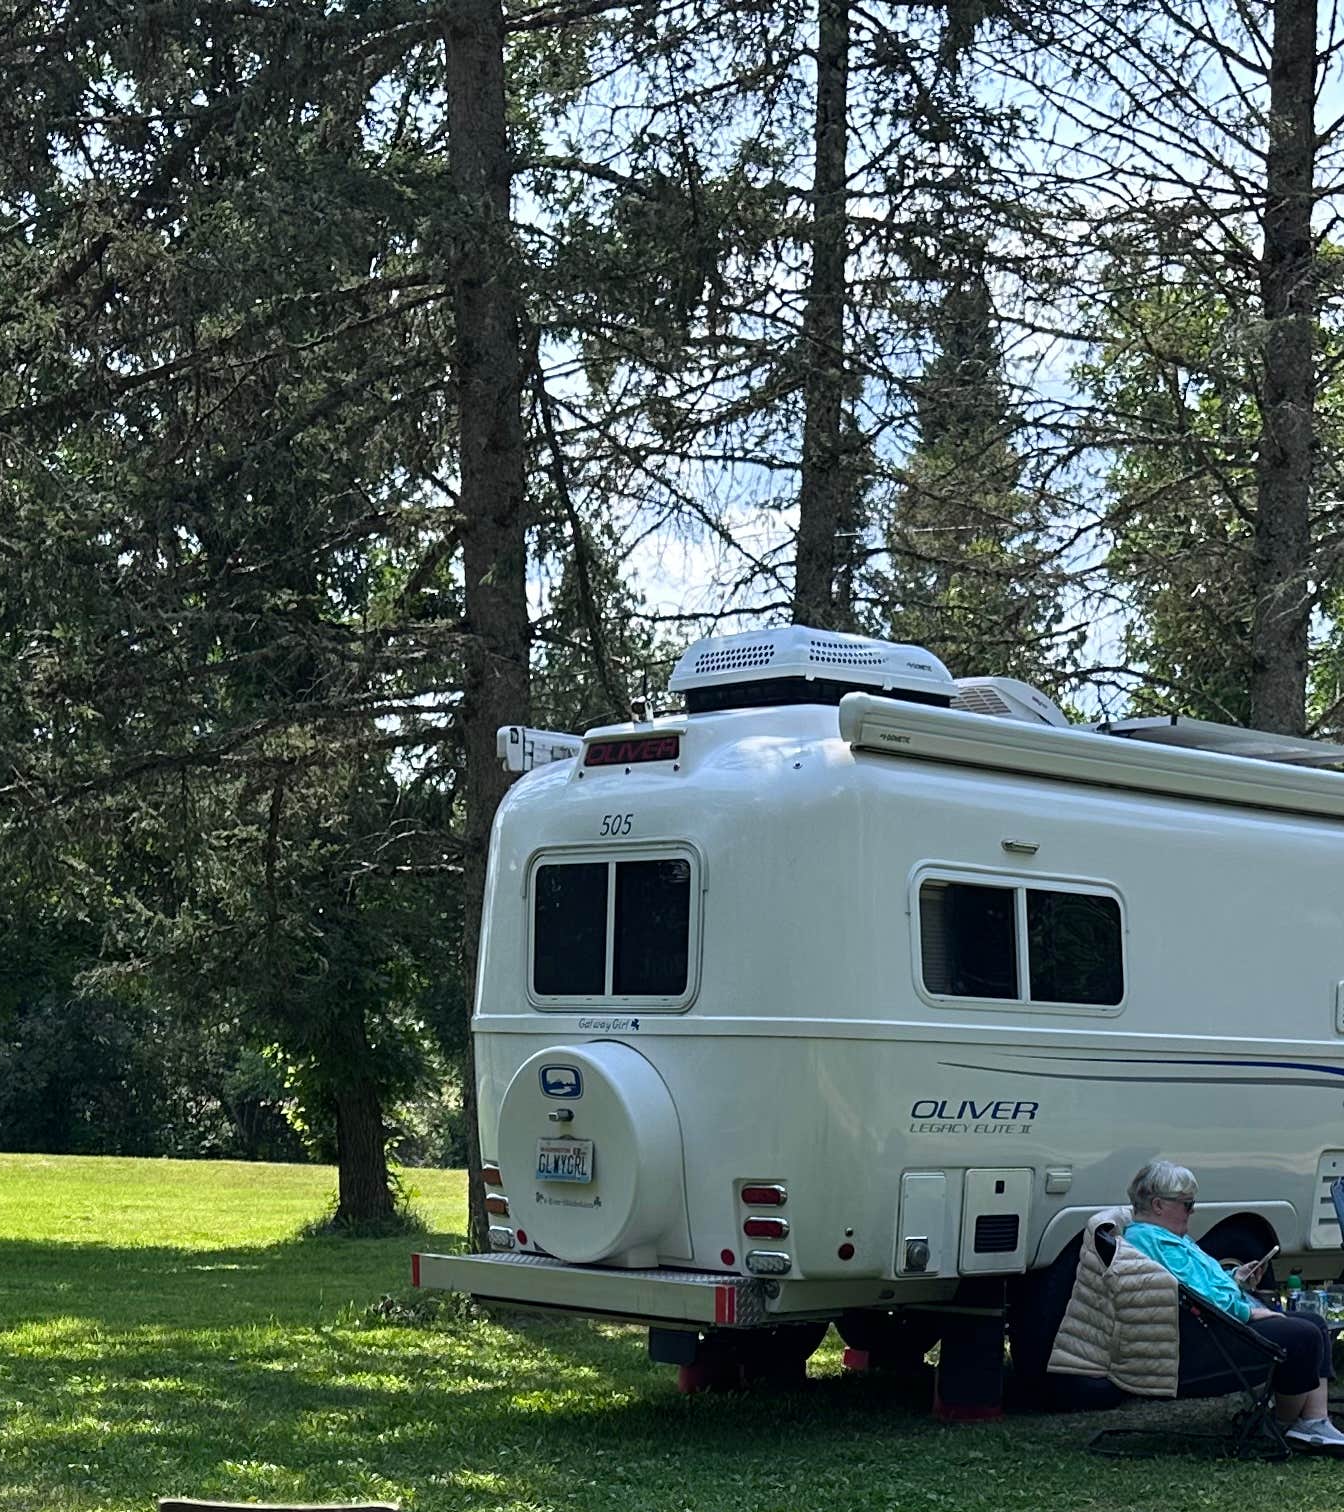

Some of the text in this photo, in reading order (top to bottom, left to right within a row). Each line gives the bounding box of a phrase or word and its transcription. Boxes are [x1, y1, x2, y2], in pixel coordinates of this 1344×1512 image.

[599, 813, 634, 836] 505
[910, 1100, 1039, 1120] OLIVER
[909, 1123, 969, 1133] LEGACY
[974, 1124, 1016, 1134] ELITE
